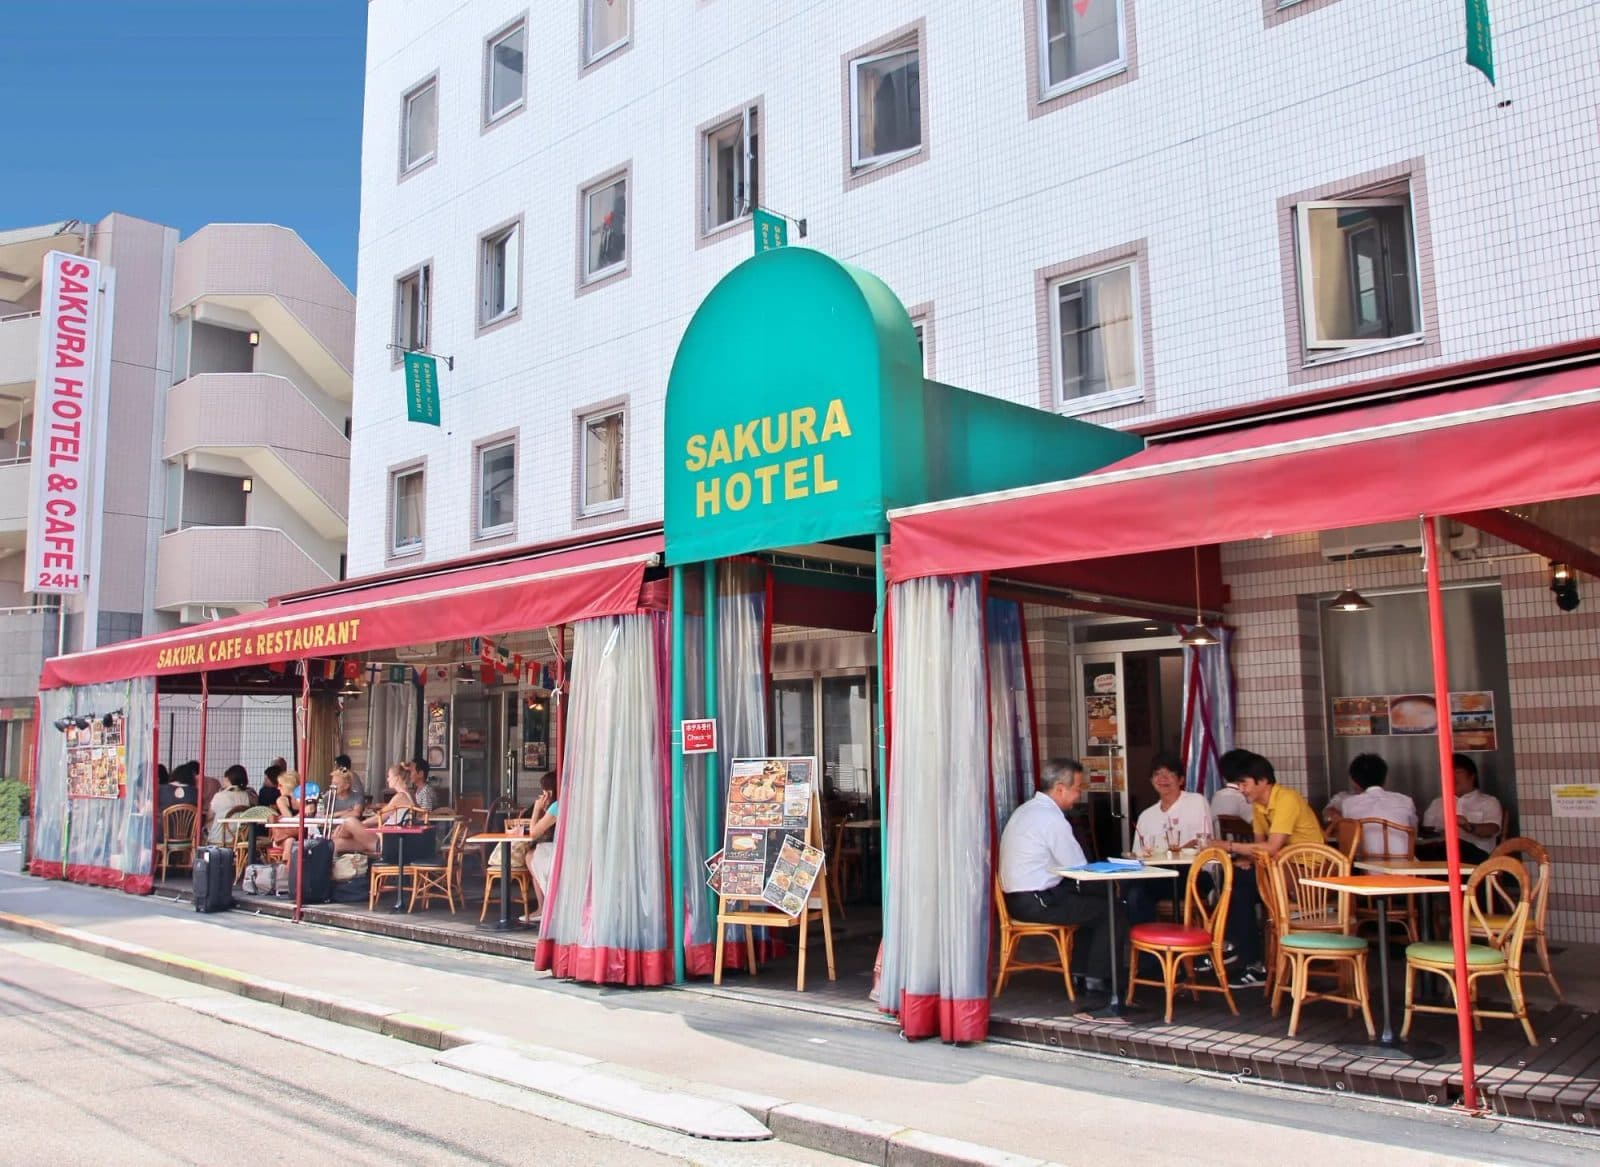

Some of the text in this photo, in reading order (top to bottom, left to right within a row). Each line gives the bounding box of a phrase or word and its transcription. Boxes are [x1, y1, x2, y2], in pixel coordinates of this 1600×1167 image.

[43, 260, 90, 570] SAKURA HOTEL & CAFE
[685, 399, 852, 472] SAKURA
[696, 454, 838, 518] HOTEL
[38, 572, 78, 588] 24H
[157, 619, 360, 669] SAKURA CAFE & RESTAURANT
